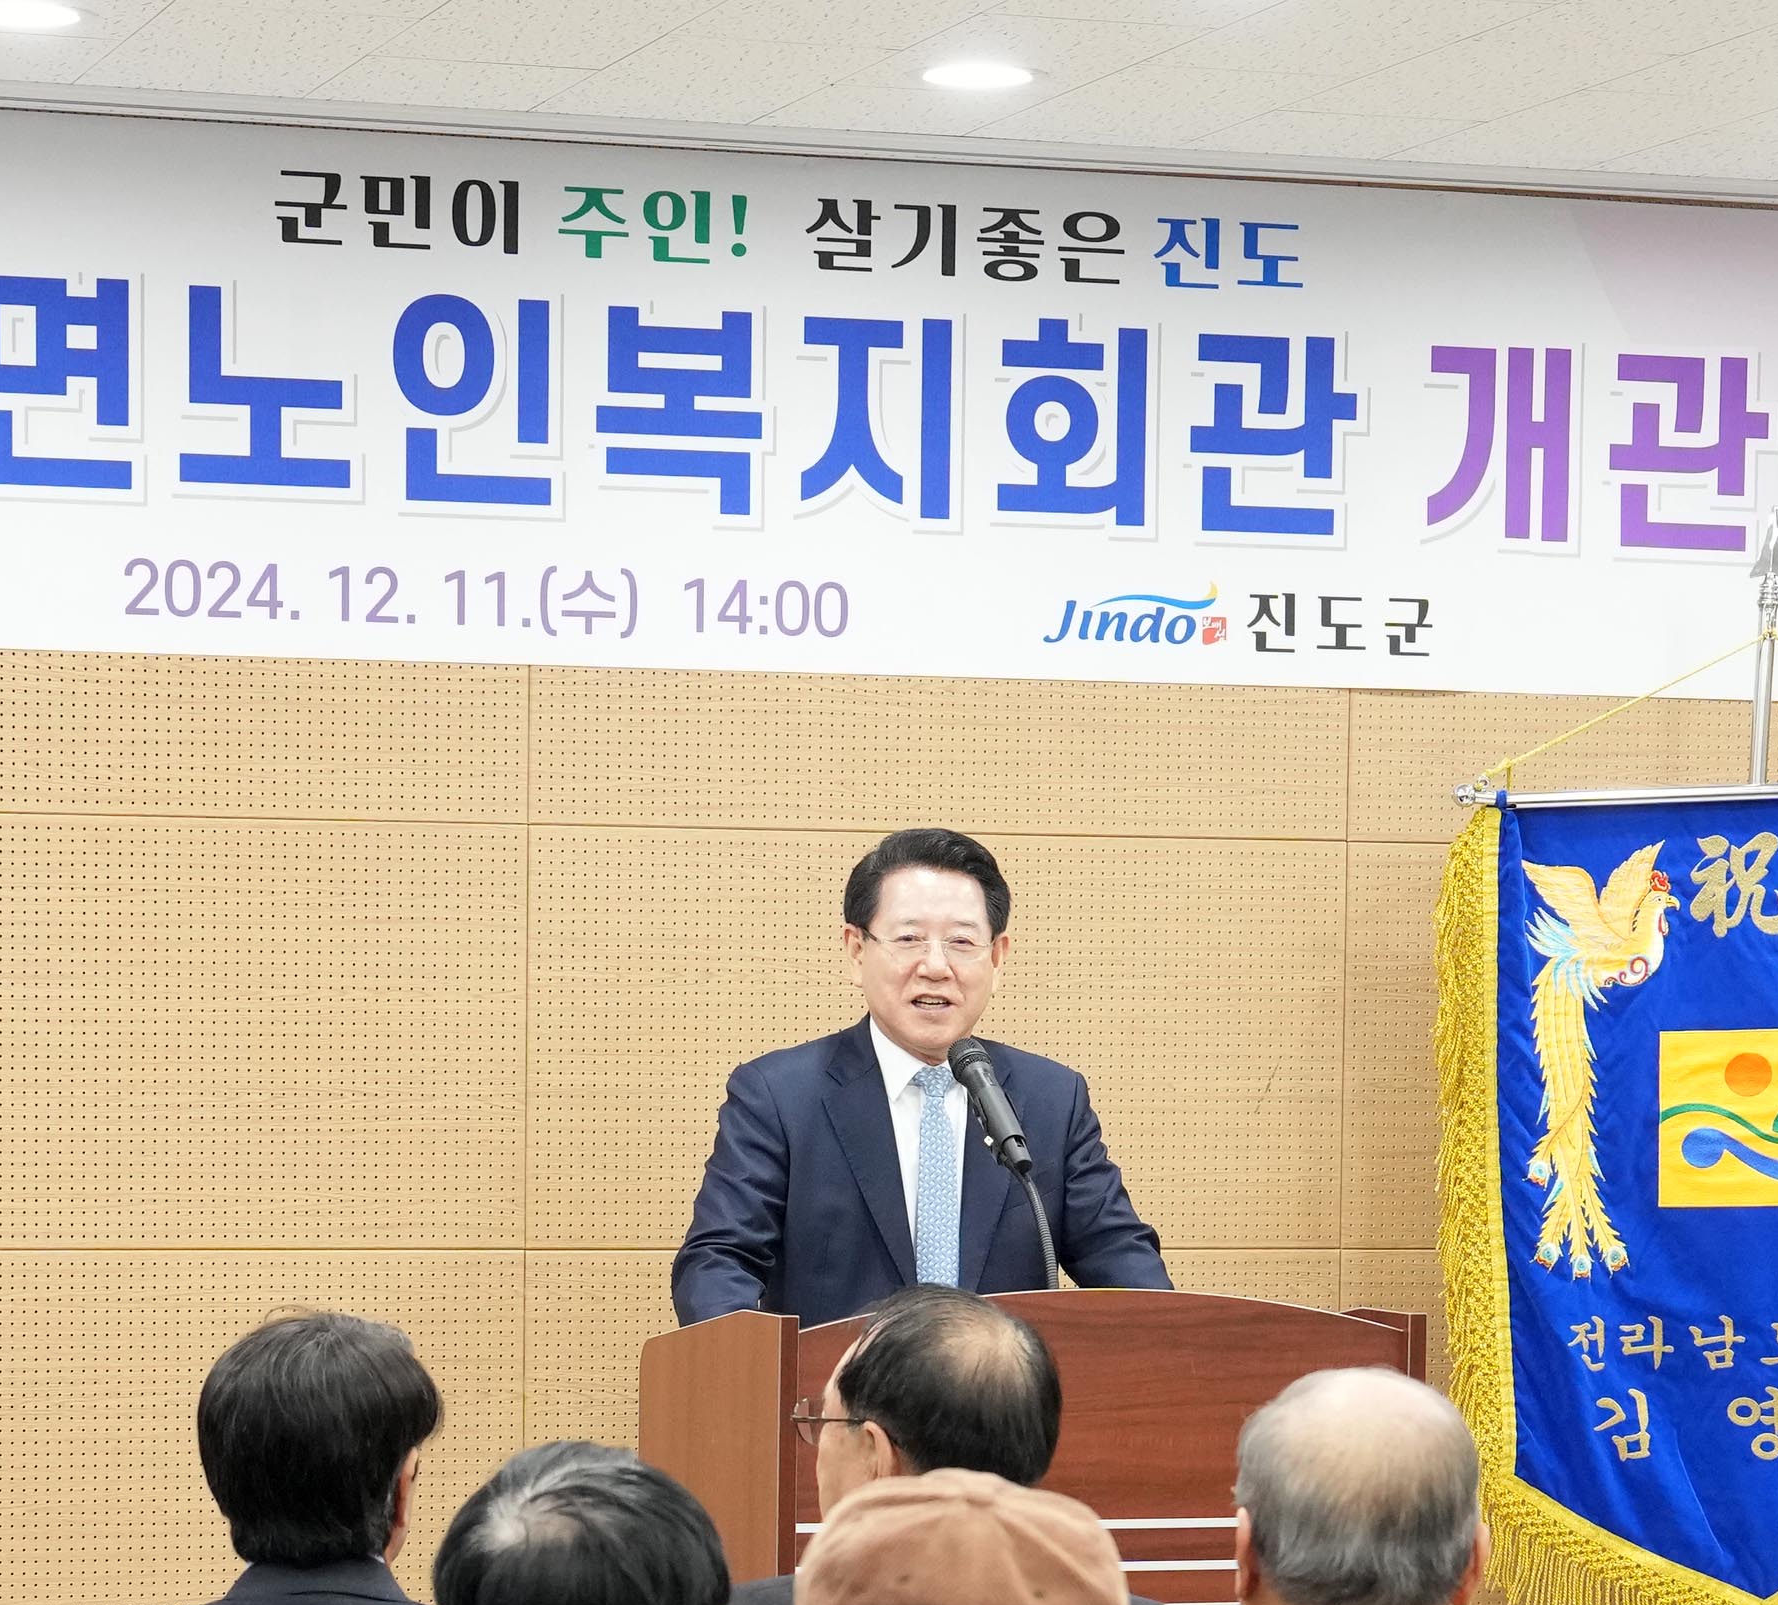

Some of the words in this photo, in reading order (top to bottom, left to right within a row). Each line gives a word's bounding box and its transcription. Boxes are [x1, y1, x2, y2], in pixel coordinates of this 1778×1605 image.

[275, 170, 519, 254] 군민이
[557, 187, 748, 265] 주인!
[804, 197, 1126, 285] 살기좋은
[1154, 218, 1303, 290] 진도
[124, 559, 304, 620] 2024.
[329, 566, 418, 625] 12.
[447, 568, 639, 636] 11.(수)
[683, 578, 850, 638] 14:00
[1043, 598, 1197, 645] Jindo
[1246, 592, 1434, 657] 진도군
